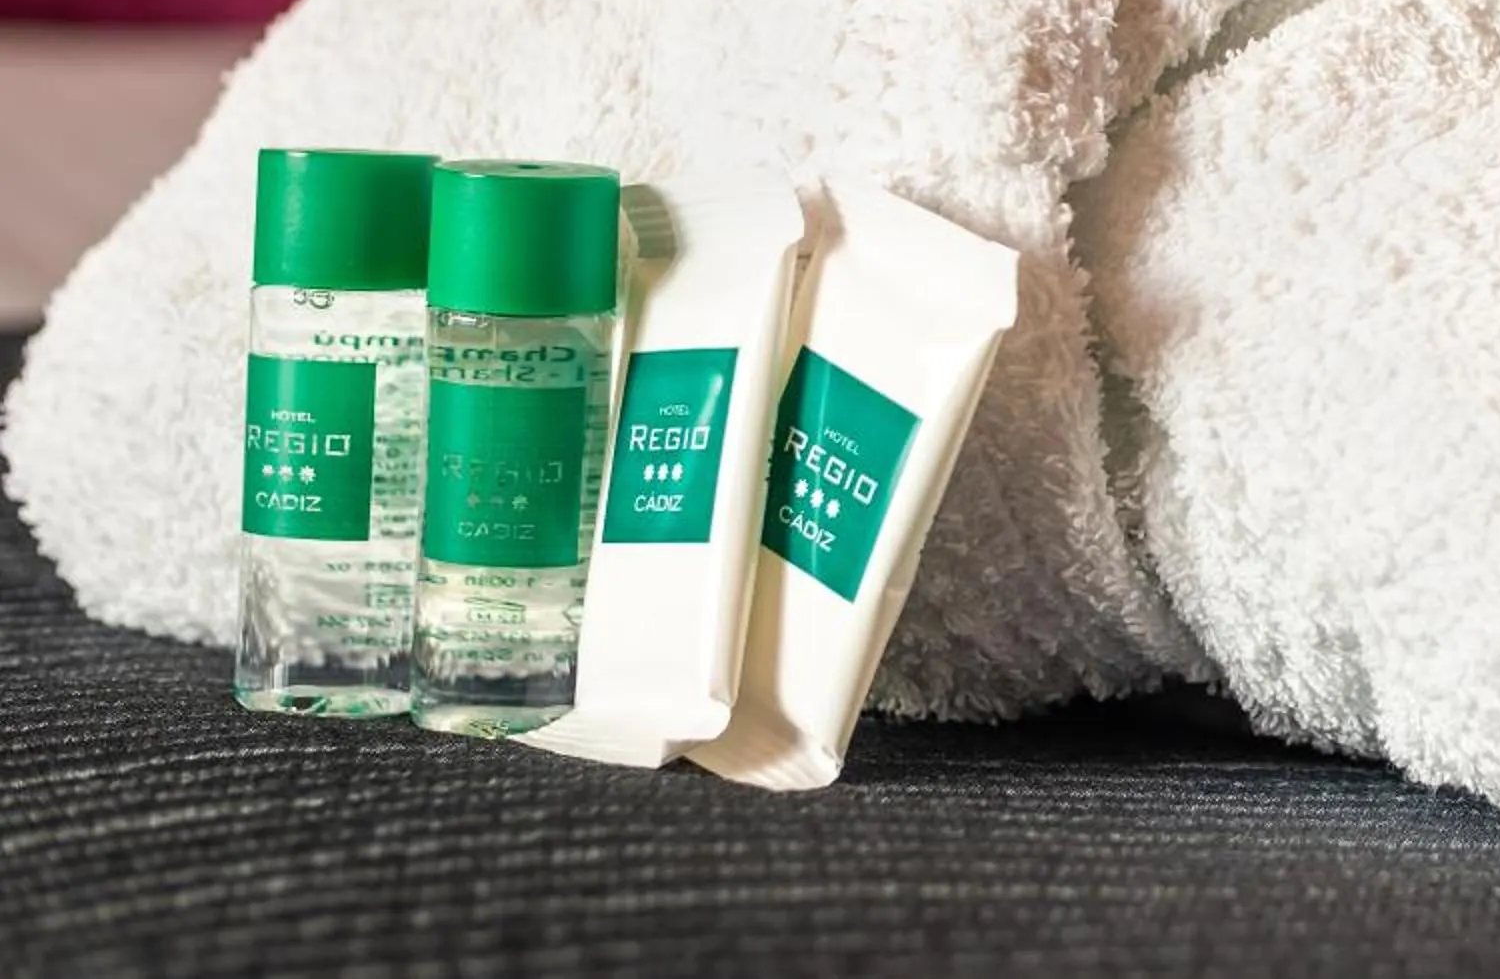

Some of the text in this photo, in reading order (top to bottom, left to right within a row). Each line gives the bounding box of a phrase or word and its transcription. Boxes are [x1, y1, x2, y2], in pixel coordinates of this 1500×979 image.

[271, 409, 317, 423] HOTEL
[660, 404, 690, 416] HOTEL
[247, 424, 352, 456] REGIO
[629, 424, 711, 451] REGIO
[823, 426, 860, 456] HOTEL
[783, 426, 879, 506] REGIO
